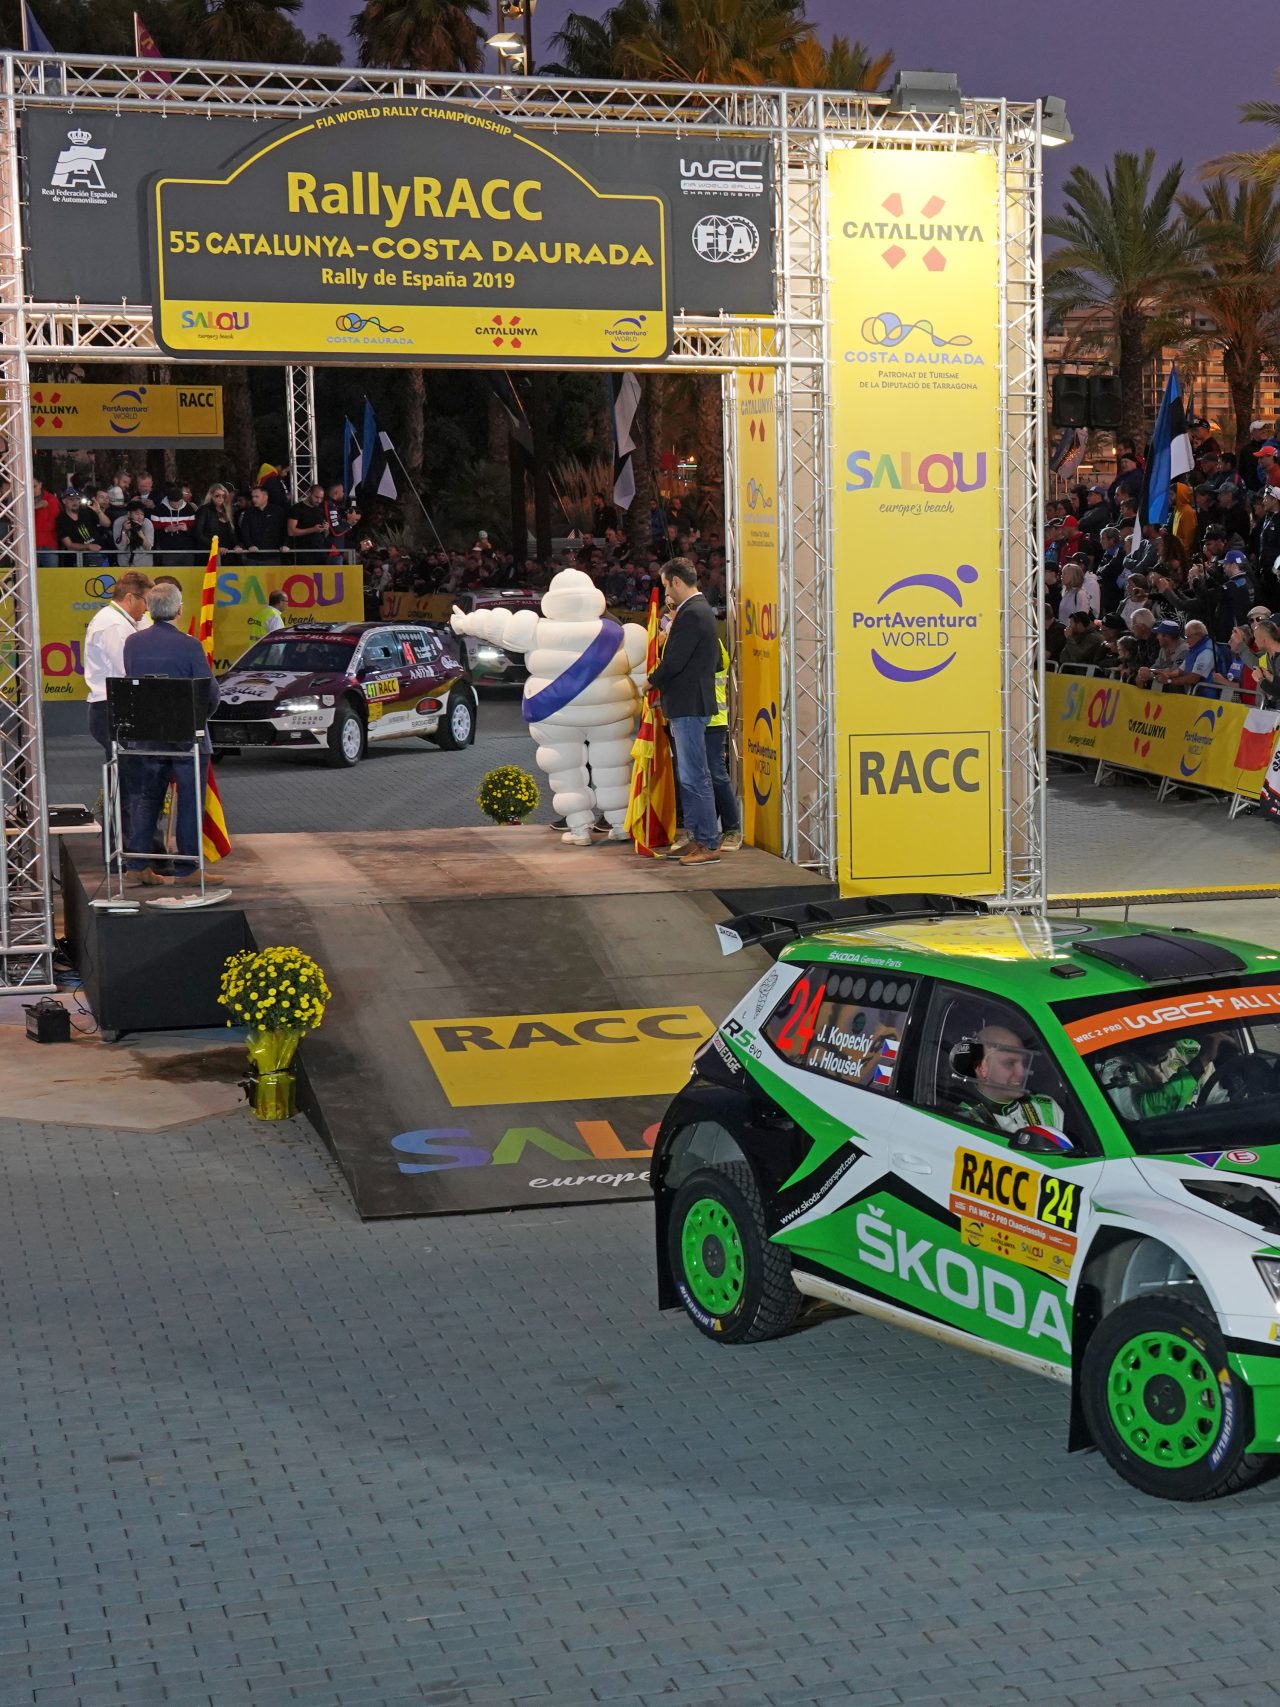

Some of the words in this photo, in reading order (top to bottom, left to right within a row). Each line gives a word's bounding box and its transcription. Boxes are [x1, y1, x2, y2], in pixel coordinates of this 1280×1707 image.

[315, 116, 336, 129] FIA
[337, 108, 381, 124] WORLD
[382, 107, 419, 119] RALLY
[421, 107, 512, 136] CHAMPIONSHIP
[680, 158, 763, 180] WRC
[41, 188, 55, 197] Real
[56, 189, 89, 198] Federación
[90, 191, 118, 200] Española
[53, 195, 61, 203] de
[62, 196, 108, 205] Automovilismo
[287, 171, 542, 228] RallyRACC
[842, 221, 985, 242] CATALUNYA
[169, 230, 200, 254] 55
[493, 240, 655, 266] DAURADA
[322, 268, 368, 289] Rally
[373, 269, 396, 286] de
[402, 270, 467, 291] España
[472, 272, 515, 289] 2019
[181, 310, 250, 330] SALOU
[326, 336, 360, 344] COSTA
[363, 337, 414, 345] DAURADA
[475, 326, 538, 336] CATALUNYA
[604, 329, 647, 337] PortAventura
[844, 351, 898, 364] COSTA
[904, 352, 985, 365] DAURADA
[30, 406, 79, 415] TALUNYA
[102, 405, 148, 413] PortAventura
[179, 392, 214, 408] RACC
[846, 450, 986, 493] SALOU
[879, 501, 922, 516] europe's
[923, 501, 955, 513] beach
[852, 612, 978, 629] PortAventura
[882, 631, 949, 648] WORLD
[44, 683, 74, 694] beach
[1128, 719, 1167, 739] CATALUNYA
[859, 748, 979, 796] RACC
[827, 951, 860, 963] ŠKODA
[860, 955, 885, 968] Genuine
[885, 958, 902, 968] Parts
[1230, 994, 1269, 1010] ALL
[776, 977, 826, 1055] 24
[433, 1014, 703, 1053] RACC
[723, 1017, 757, 1048] R5
[817, 1024, 825, 1042] J.
[827, 1026, 874, 1053] Kopecký
[1073, 1029, 1096, 1044] WRC
[1104, 1023, 1123, 1034] PRO
[720, 1046, 742, 1075] EDGE
[748, 1043, 763, 1060] evo
[809, 1050, 818, 1067] J.
[820, 1053, 864, 1079] Hloušek
[391, 1120, 662, 1174] SAL
[1233, 1152, 1250, 1161] E
[528, 1170, 651, 1188] europe
[779, 1151, 857, 1225] www.skoda-motorsport.com
[960, 1152, 1030, 1212] RACC
[1041, 1178, 1076, 1229] 24
[969, 1205, 978, 1216] FIA
[979, 1208, 990, 1220] WRC
[996, 1214, 1008, 1226] PRO
[1008, 1219, 1046, 1241] Championship
[855, 1203, 1072, 1355] ŠKODA
[679, 1285, 710, 1327] MICHELIN
[1212, 1397, 1234, 1464] MICHELIN
